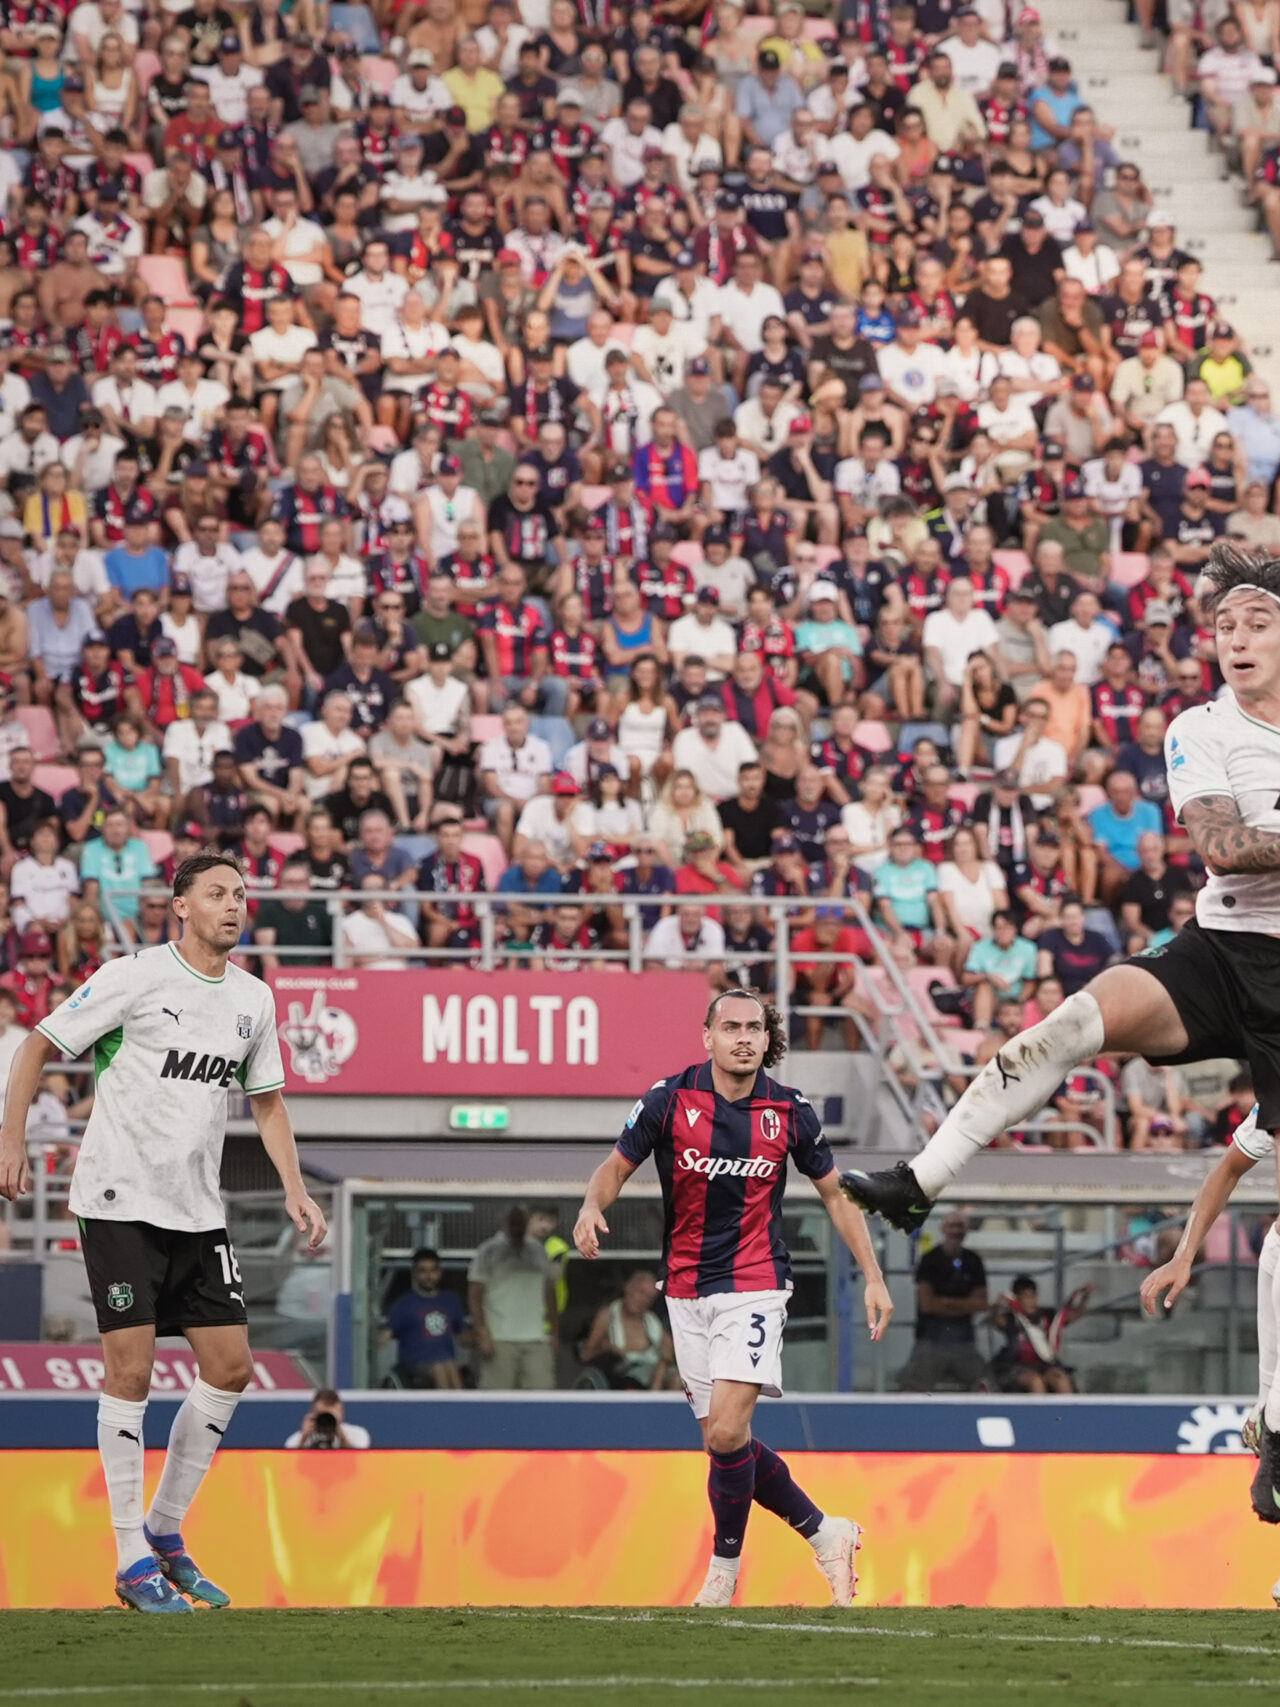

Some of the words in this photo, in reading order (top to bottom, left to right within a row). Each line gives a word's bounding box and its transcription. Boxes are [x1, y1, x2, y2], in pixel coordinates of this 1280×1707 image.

[422, 994, 599, 1065] MALTA
[677, 1148, 777, 1181] Saputo
[747, 1313, 766, 1348] 3
[45, 1357, 276, 1389] SPCII
